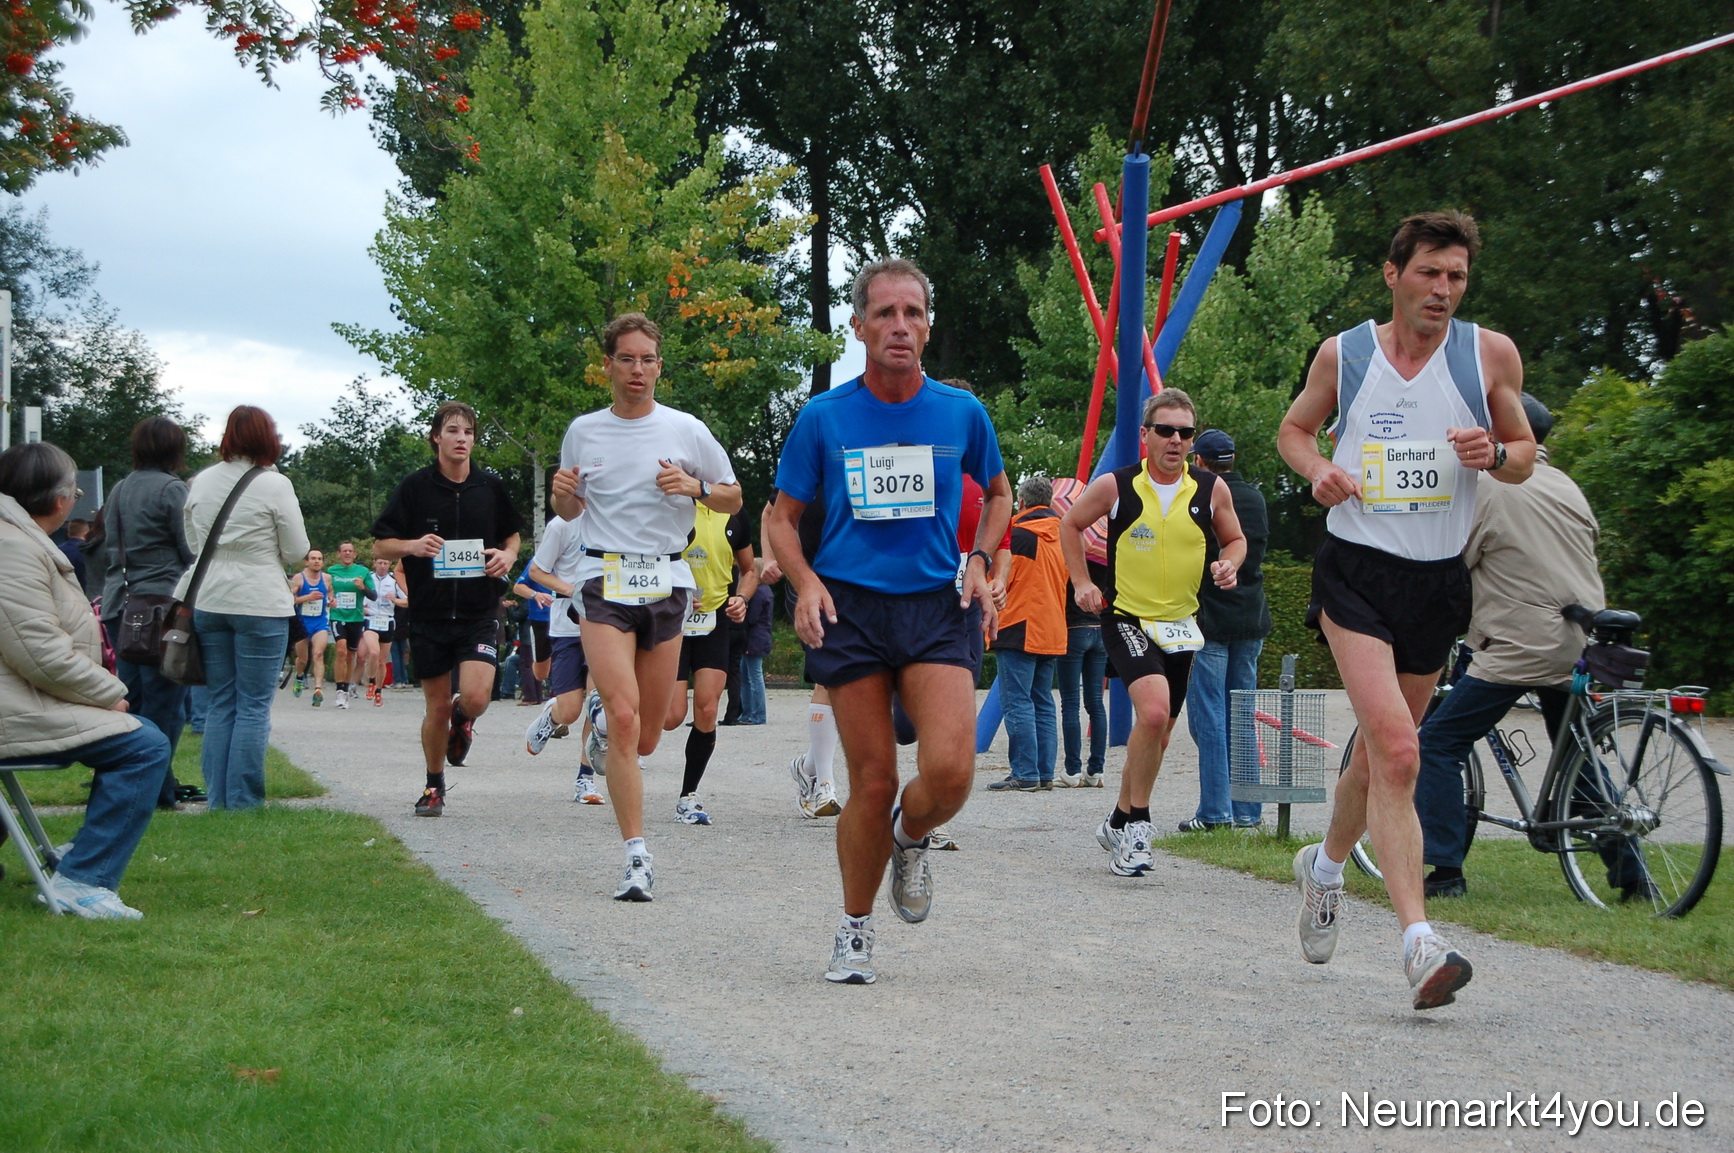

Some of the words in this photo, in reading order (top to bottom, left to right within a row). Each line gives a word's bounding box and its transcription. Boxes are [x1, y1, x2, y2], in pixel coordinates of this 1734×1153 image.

[1387, 447, 1435, 461] Gerhard
[869, 456, 894, 470] Luigi
[852, 477, 858, 486] A
[1366, 469, 1372, 480] A
[1396, 469, 1439, 489] 330
[873, 474, 925, 494] 3078
[449, 551, 480, 562] 3484
[621, 559, 655, 570] Carsten
[628, 574, 660, 588] 484
[1164, 626, 1192, 639] 376
[1487, 731, 1517, 780] ANT
